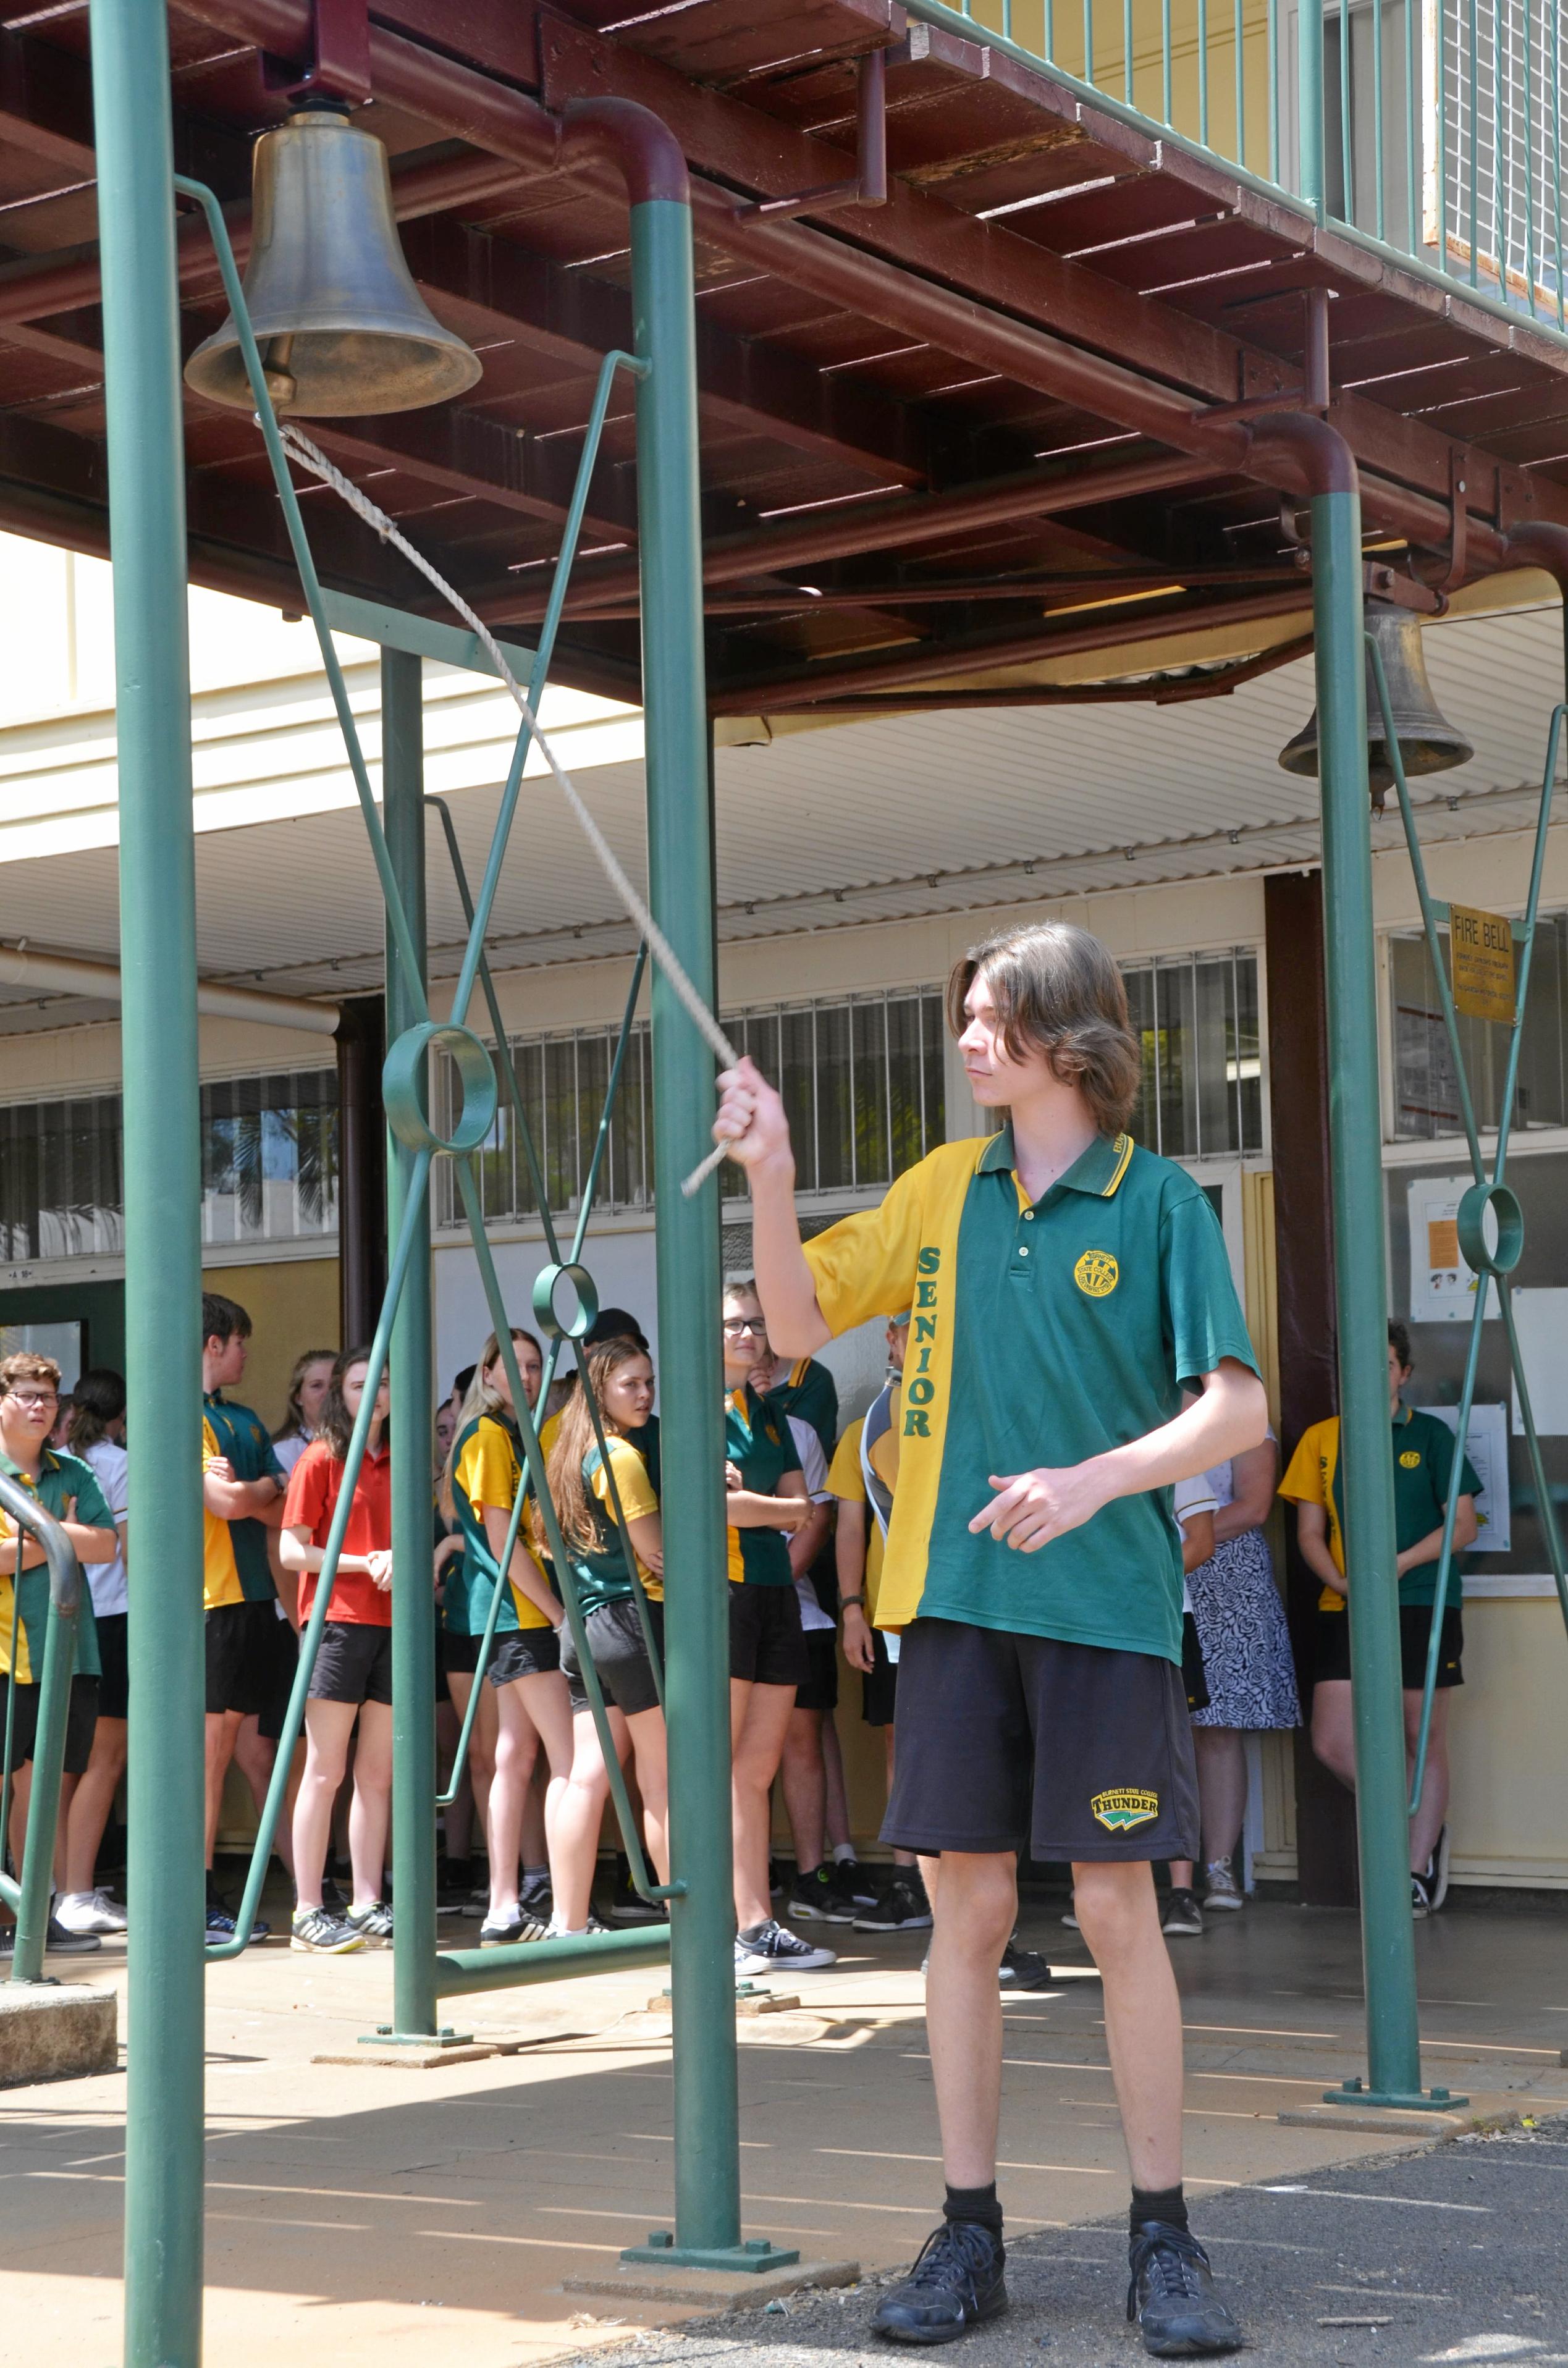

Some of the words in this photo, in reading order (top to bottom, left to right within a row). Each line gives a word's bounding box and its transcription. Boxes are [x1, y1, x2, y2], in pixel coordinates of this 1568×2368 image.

[1454, 915, 1479, 946] FIRE
[1483, 922, 1509, 953] BELL
[1078, 1266, 1092, 1274] STATE
[1094, 1266, 1115, 1283] COLLEGE
[903, 1247, 941, 1438] SENIOR
[1102, 1788, 1125, 1798] BURNETT
[1092, 1797, 1157, 1814] THUNDER
